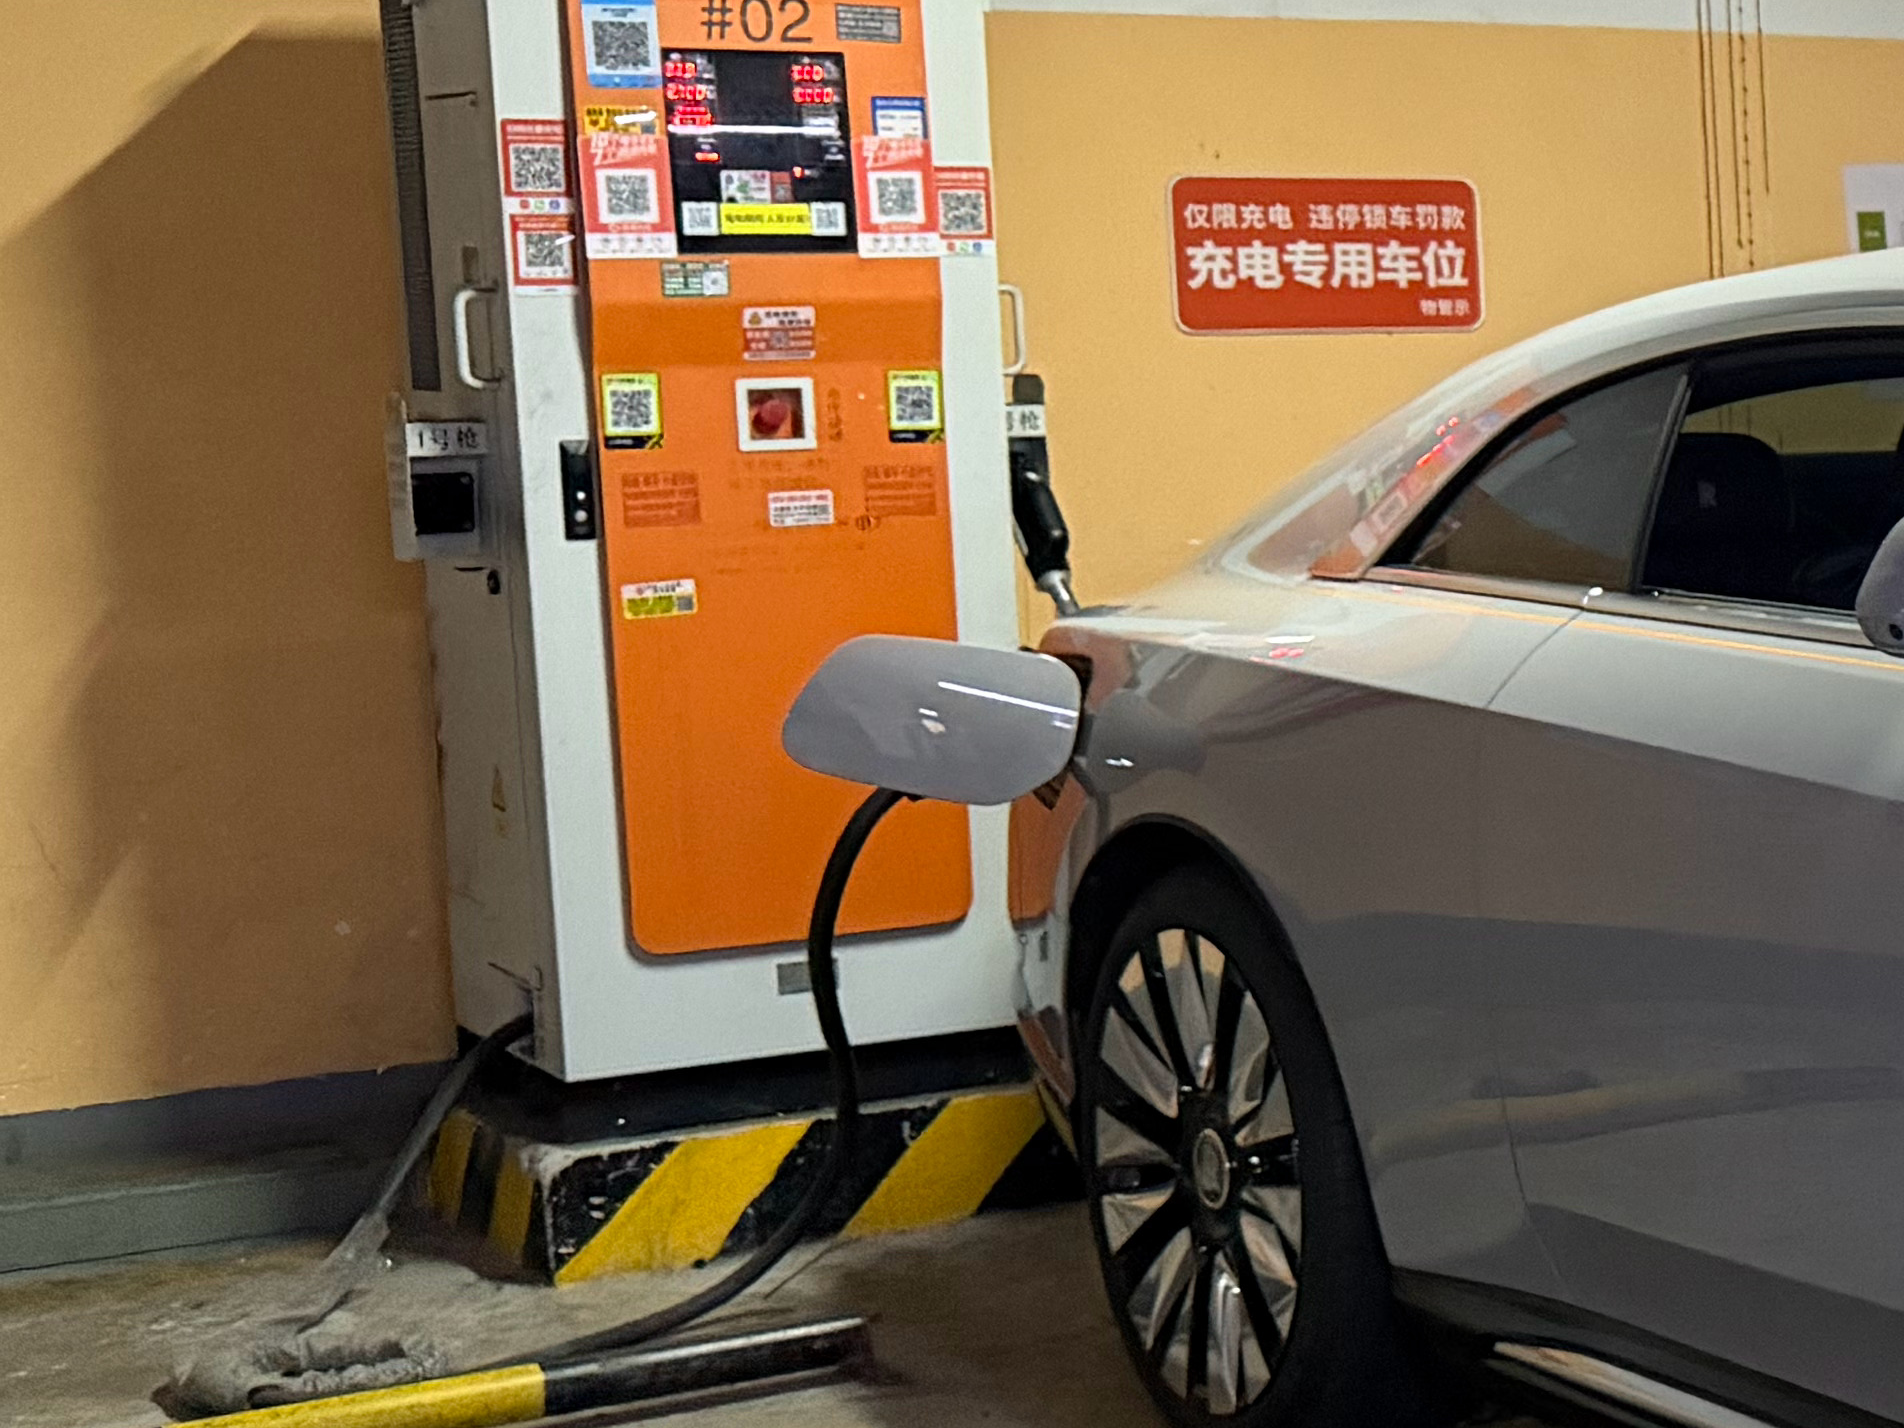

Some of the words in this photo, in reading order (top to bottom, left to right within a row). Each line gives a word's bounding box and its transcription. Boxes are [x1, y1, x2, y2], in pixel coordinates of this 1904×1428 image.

[1183, 202, 1294, 230] 仅限充电
[1185, 239, 1470, 290] 充电专用车位
